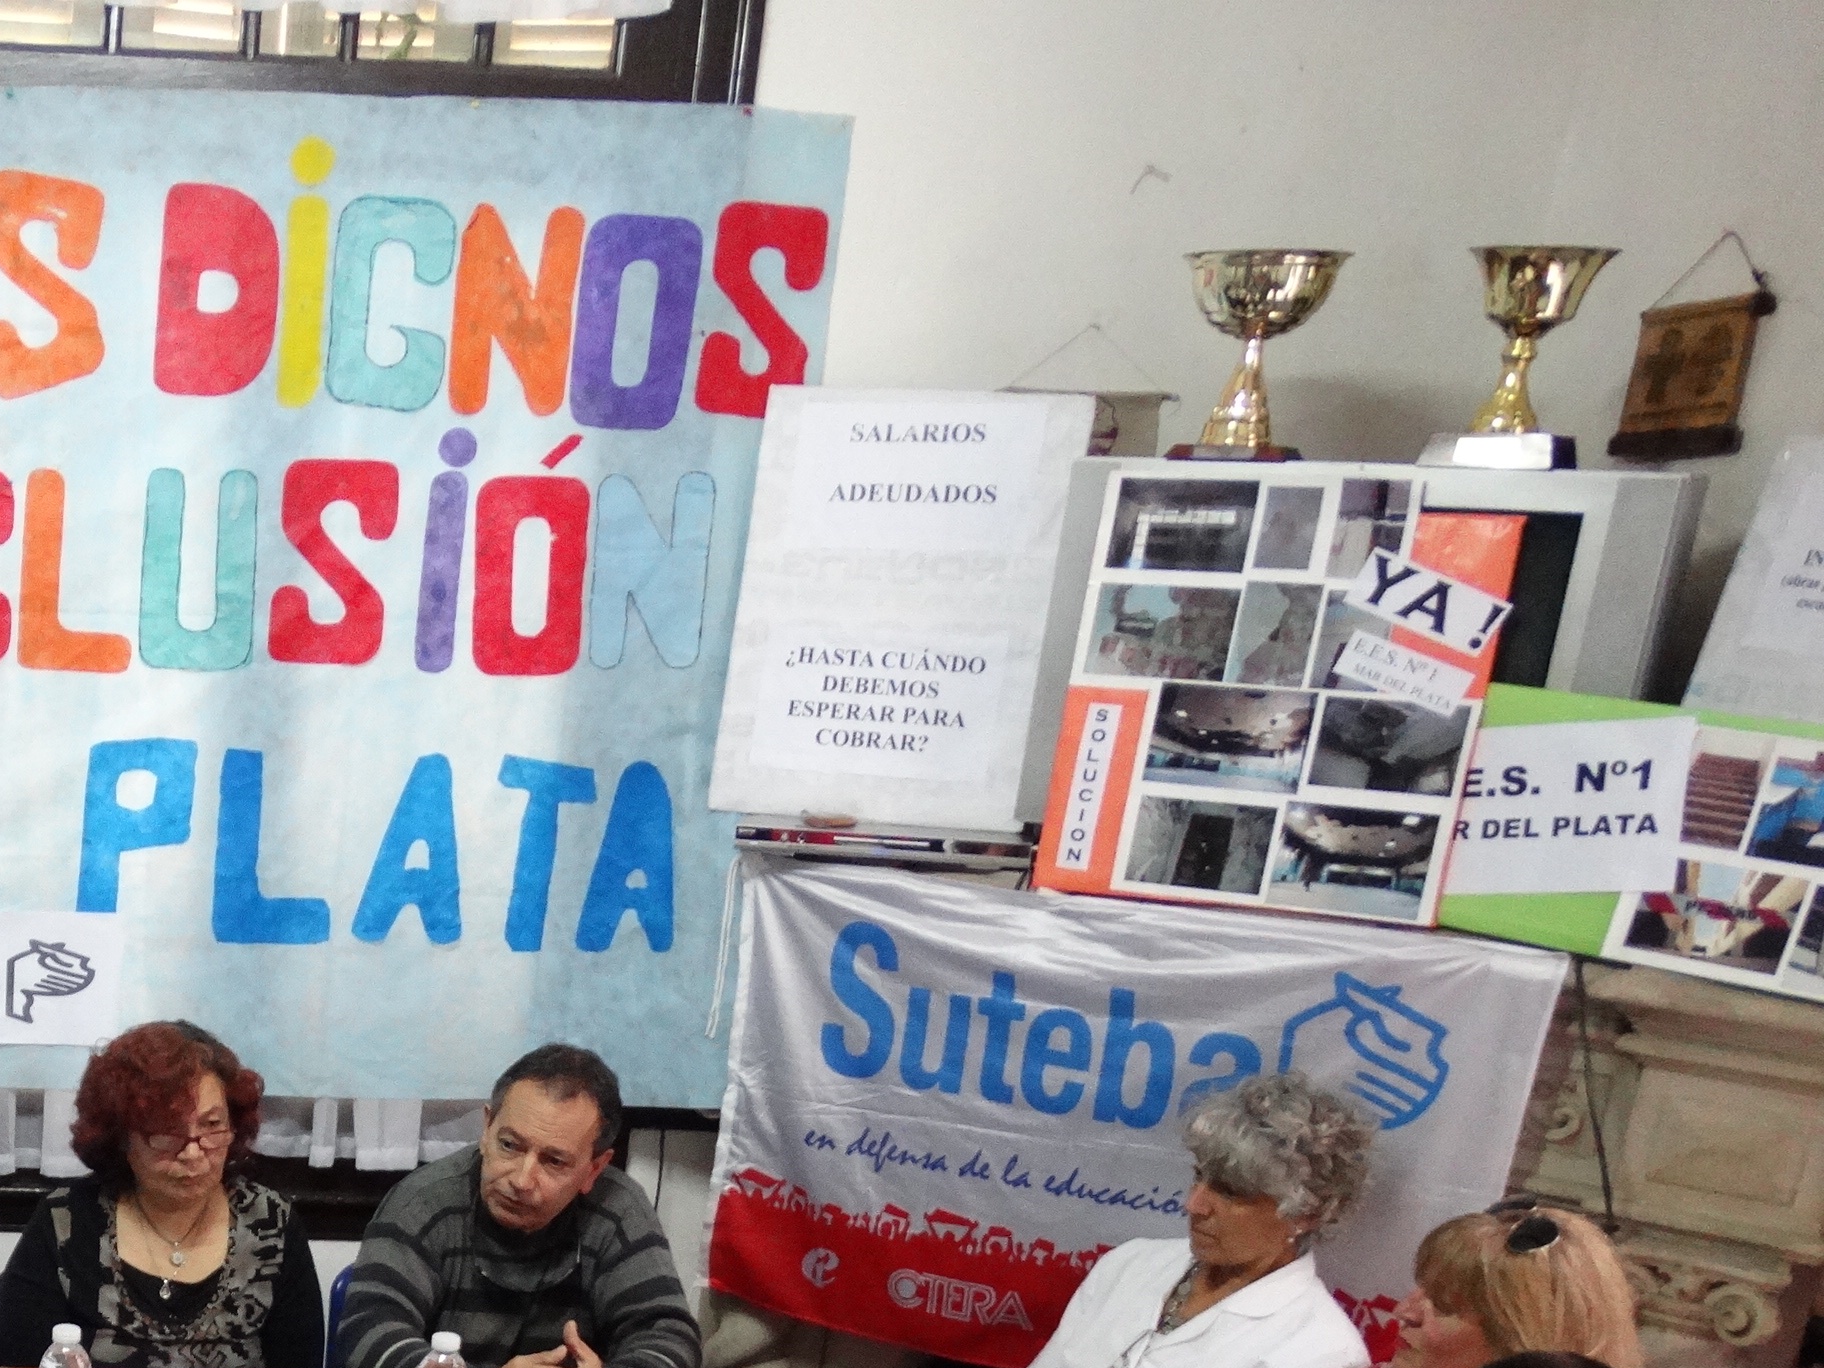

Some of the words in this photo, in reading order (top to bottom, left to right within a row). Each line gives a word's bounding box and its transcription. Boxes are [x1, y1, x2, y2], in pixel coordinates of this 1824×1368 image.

[849, 422, 988, 444] SALARIOS
[829, 483, 998, 505] ADEUDADOS
[785, 646, 875, 668] ¿HASTA
[881, 649, 987, 674] CUÁNDO
[822, 675, 940, 699] DEBEMOS
[787, 699, 895, 723] ESPERAR
[902, 706, 966, 729] PARA
[815, 729, 930, 753] COBRAR?
[1066, 709, 1109, 862] SOLUCION
[1480, 817, 1540, 840] DEL
[1551, 813, 1658, 838] PLATA
[74, 736, 674, 955] PLATA
[803, 1129, 836, 1150] en
[846, 1127, 948, 1174] defensa
[958, 1149, 990, 1181] de
[1003, 1154, 1031, 1189] la
[1043, 1168, 1188, 1217] educació
[886, 1267, 1034, 1332] CTERA
